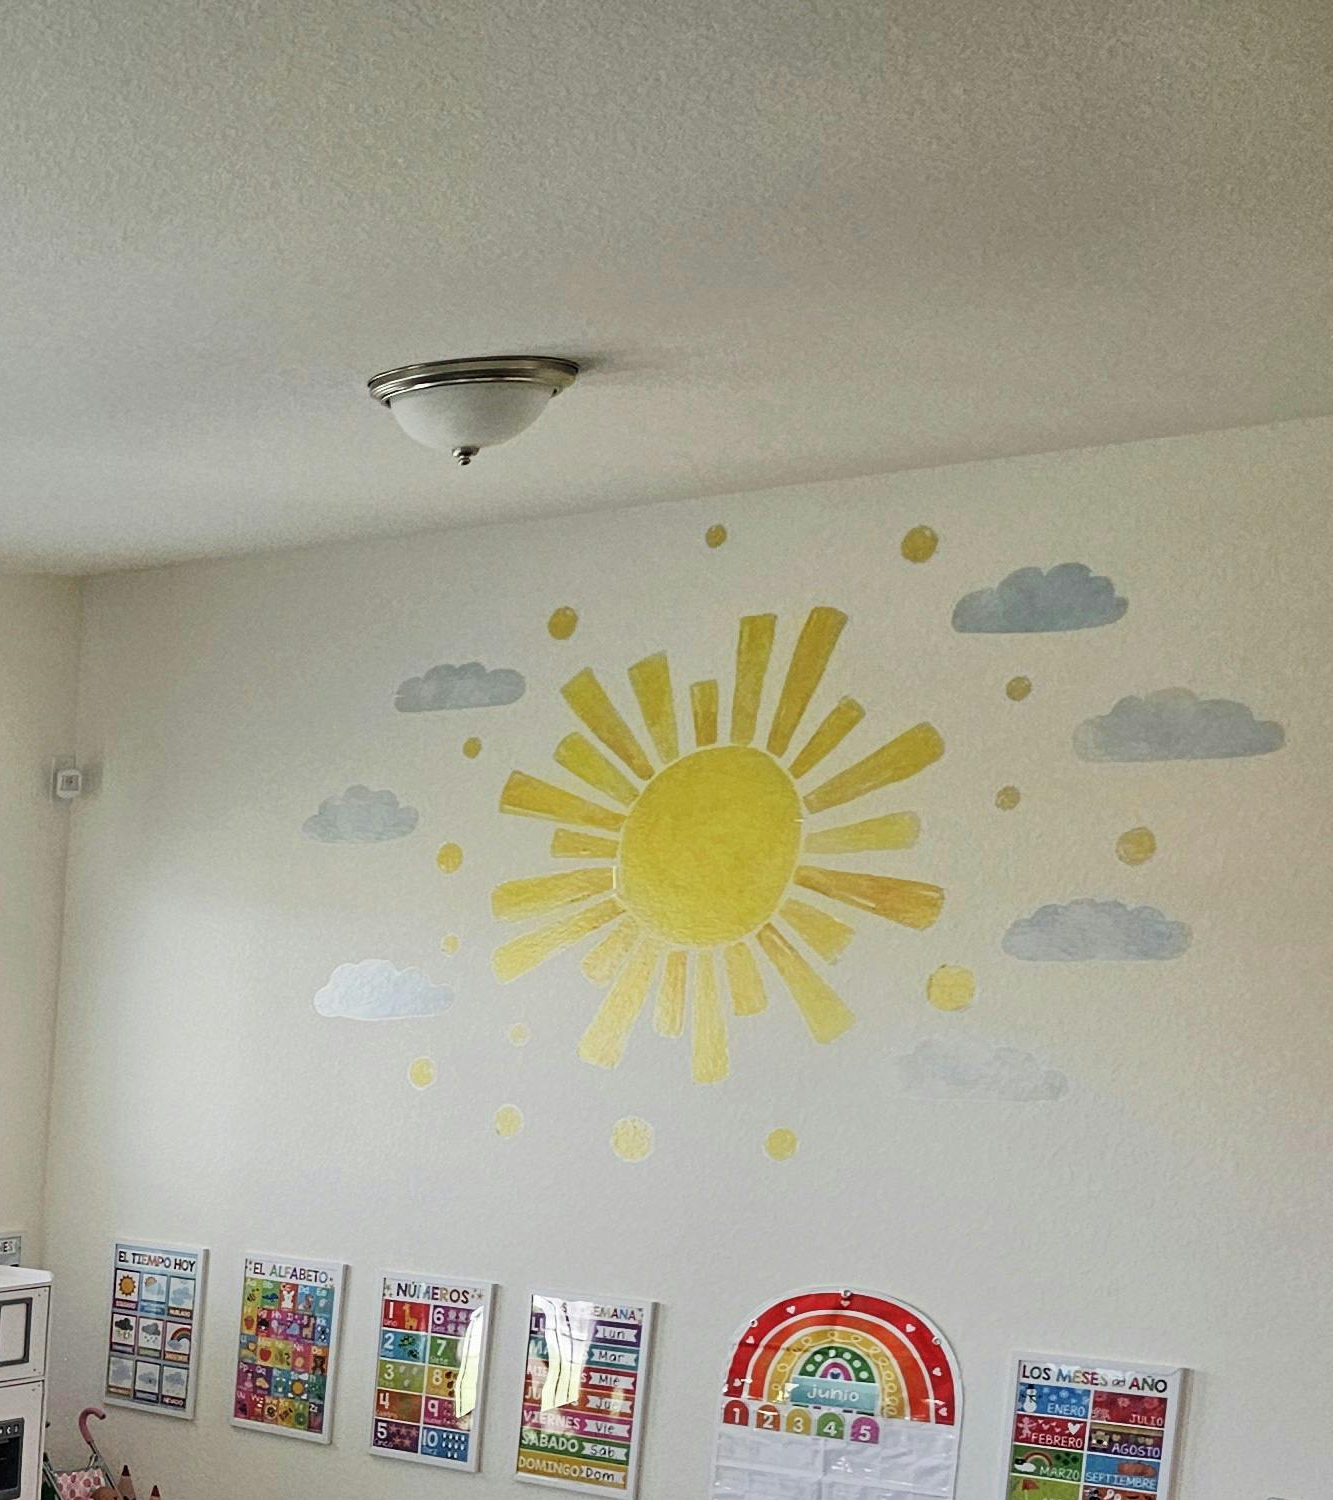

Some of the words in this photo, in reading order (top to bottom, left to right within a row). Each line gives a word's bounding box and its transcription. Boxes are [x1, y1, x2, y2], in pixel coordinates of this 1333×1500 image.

[118, 1250, 129, 1263] EL
[131, 1252, 172, 1269] TIEMPO
[173, 1258, 196, 1272] HOY
[253, 1262, 265, 1276] EL
[269, 1264, 328, 1284] ALFABETO
[388, 1301, 395, 1319] 1
[433, 1307, 445, 1325] 6
[383, 1332, 394, 1349] 2
[602, 1327, 625, 1340] Lun
[436, 1339, 447, 1356] 7
[598, 1350, 625, 1363] Mar
[384, 1364, 394, 1380] 3
[432, 1369, 442, 1386] 8
[1021, 1363, 1051, 1381] LOS
[1056, 1367, 1108, 1387] MESES
[1128, 1375, 1169, 1393] AÑO
[808, 1380, 860, 1402] junio
[379, 1392, 390, 1409] 4
[427, 1399, 439, 1417] 9
[1047, 1402, 1086, 1417] ENERO
[523, 1409, 581, 1430] VIERNES
[732, 1407, 740, 1425] 1
[762, 1413, 774, 1429] 2
[793, 1416, 804, 1432] 3
[822, 1420, 838, 1437] 4
[859, 1424, 872, 1441] 5
[1129, 1413, 1164, 1427] JULIO
[376, 1421, 388, 1439] 5
[422, 1429, 439, 1447] 10
[1031, 1432, 1083, 1449] FEBRERO
[1111, 1442, 1161, 1459] AGOSTO
[518, 1456, 580, 1477] DOMINGO
[585, 1467, 615, 1482] Dom
[1039, 1465, 1080, 1481] MARZO
[1085, 1471, 1158, 1490] SEPTIEMBRE
